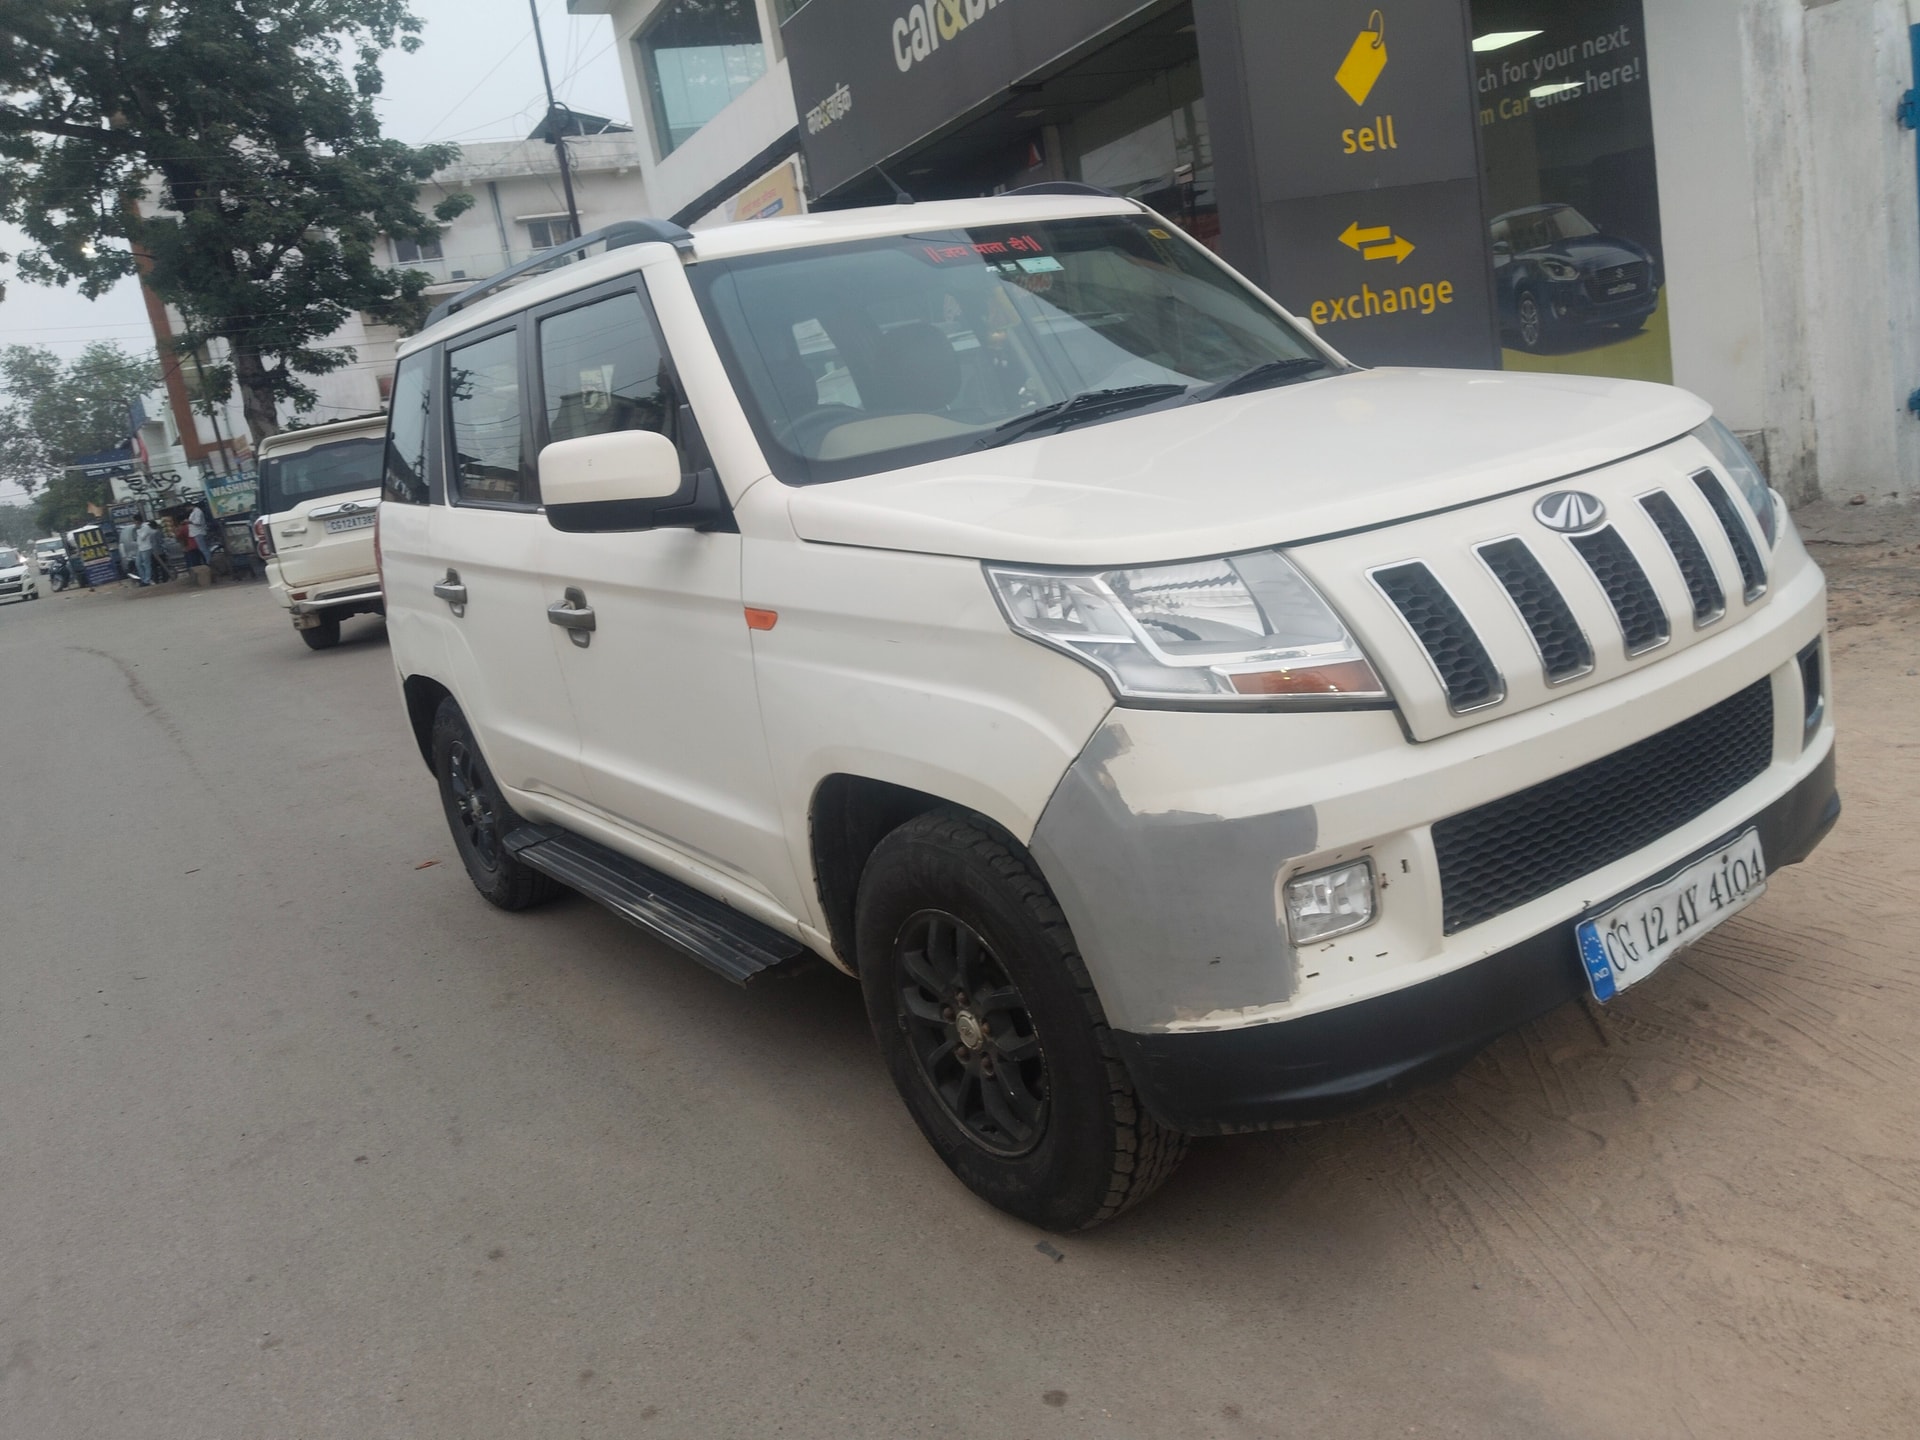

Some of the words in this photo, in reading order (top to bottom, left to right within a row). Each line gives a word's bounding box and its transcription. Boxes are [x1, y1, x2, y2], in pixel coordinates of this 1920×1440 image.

[1502, 62, 1529, 85] for
[1532, 45, 1577, 80] your
[1582, 25, 1630, 58] next
[1500, 96, 1529, 119] Car
[1585, 57, 1641, 94] here!
[1342, 115, 1397, 154] sell
[1311, 280, 1454, 325] exchange
[1606, 922, 1639, 972] CG
[1641, 906, 1669, 952] 12
[1675, 884, 1700, 936] AY
[1709, 848, 1763, 910] 4104
